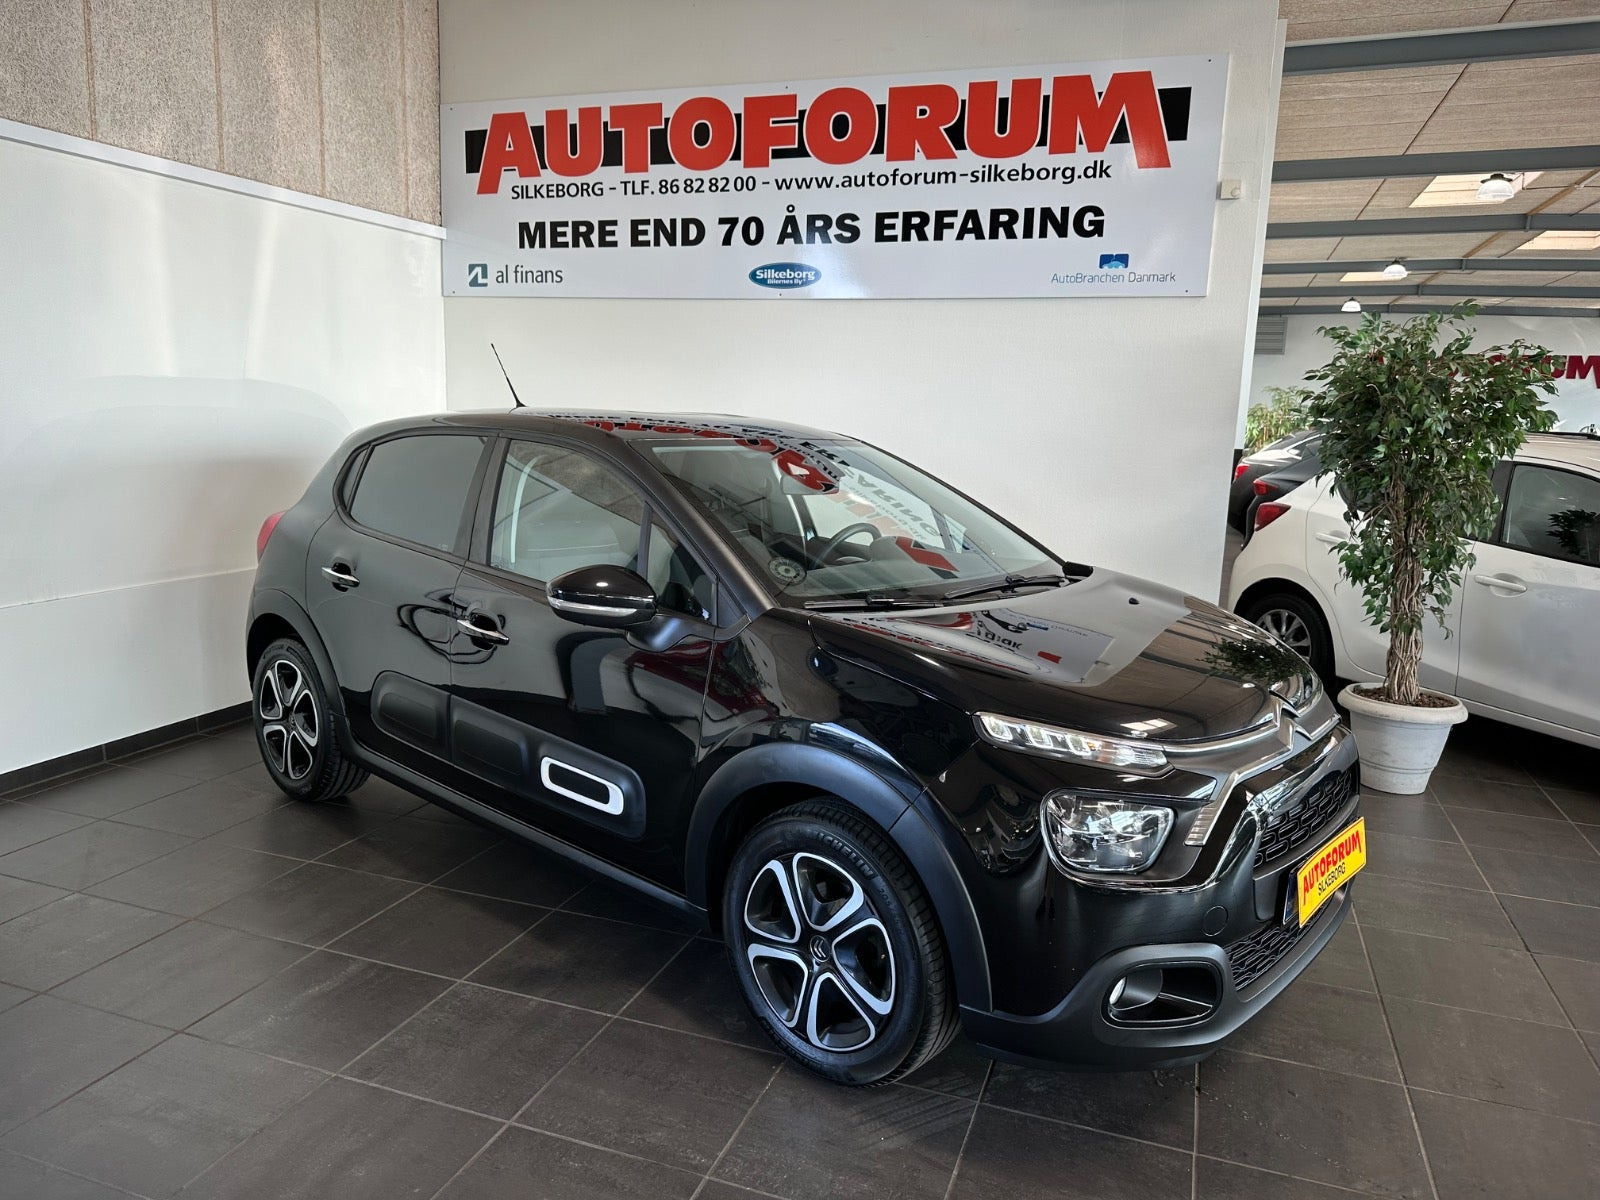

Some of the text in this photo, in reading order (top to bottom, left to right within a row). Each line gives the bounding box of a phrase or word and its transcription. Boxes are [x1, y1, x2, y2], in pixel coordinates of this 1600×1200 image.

[477, 71, 1171, 195] AUTOFORUM
[511, 181, 604, 200] SILKEBORG
[620, 180, 655, 196] TLF.
[775, 160, 1112, 190] www.autoforum-silkeborg.dk
[518, 204, 1105, 249] MERE END 70 ÅRS ERFARING
[495, 264, 563, 284] al finans
[755, 269, 816, 281] Silkeborg
[1050, 271, 1177, 284] AutoBranchen Danmark
[1303, 830, 1362, 907] AUTOFORUM
[1318, 861, 1346, 897] SILKEBORG
